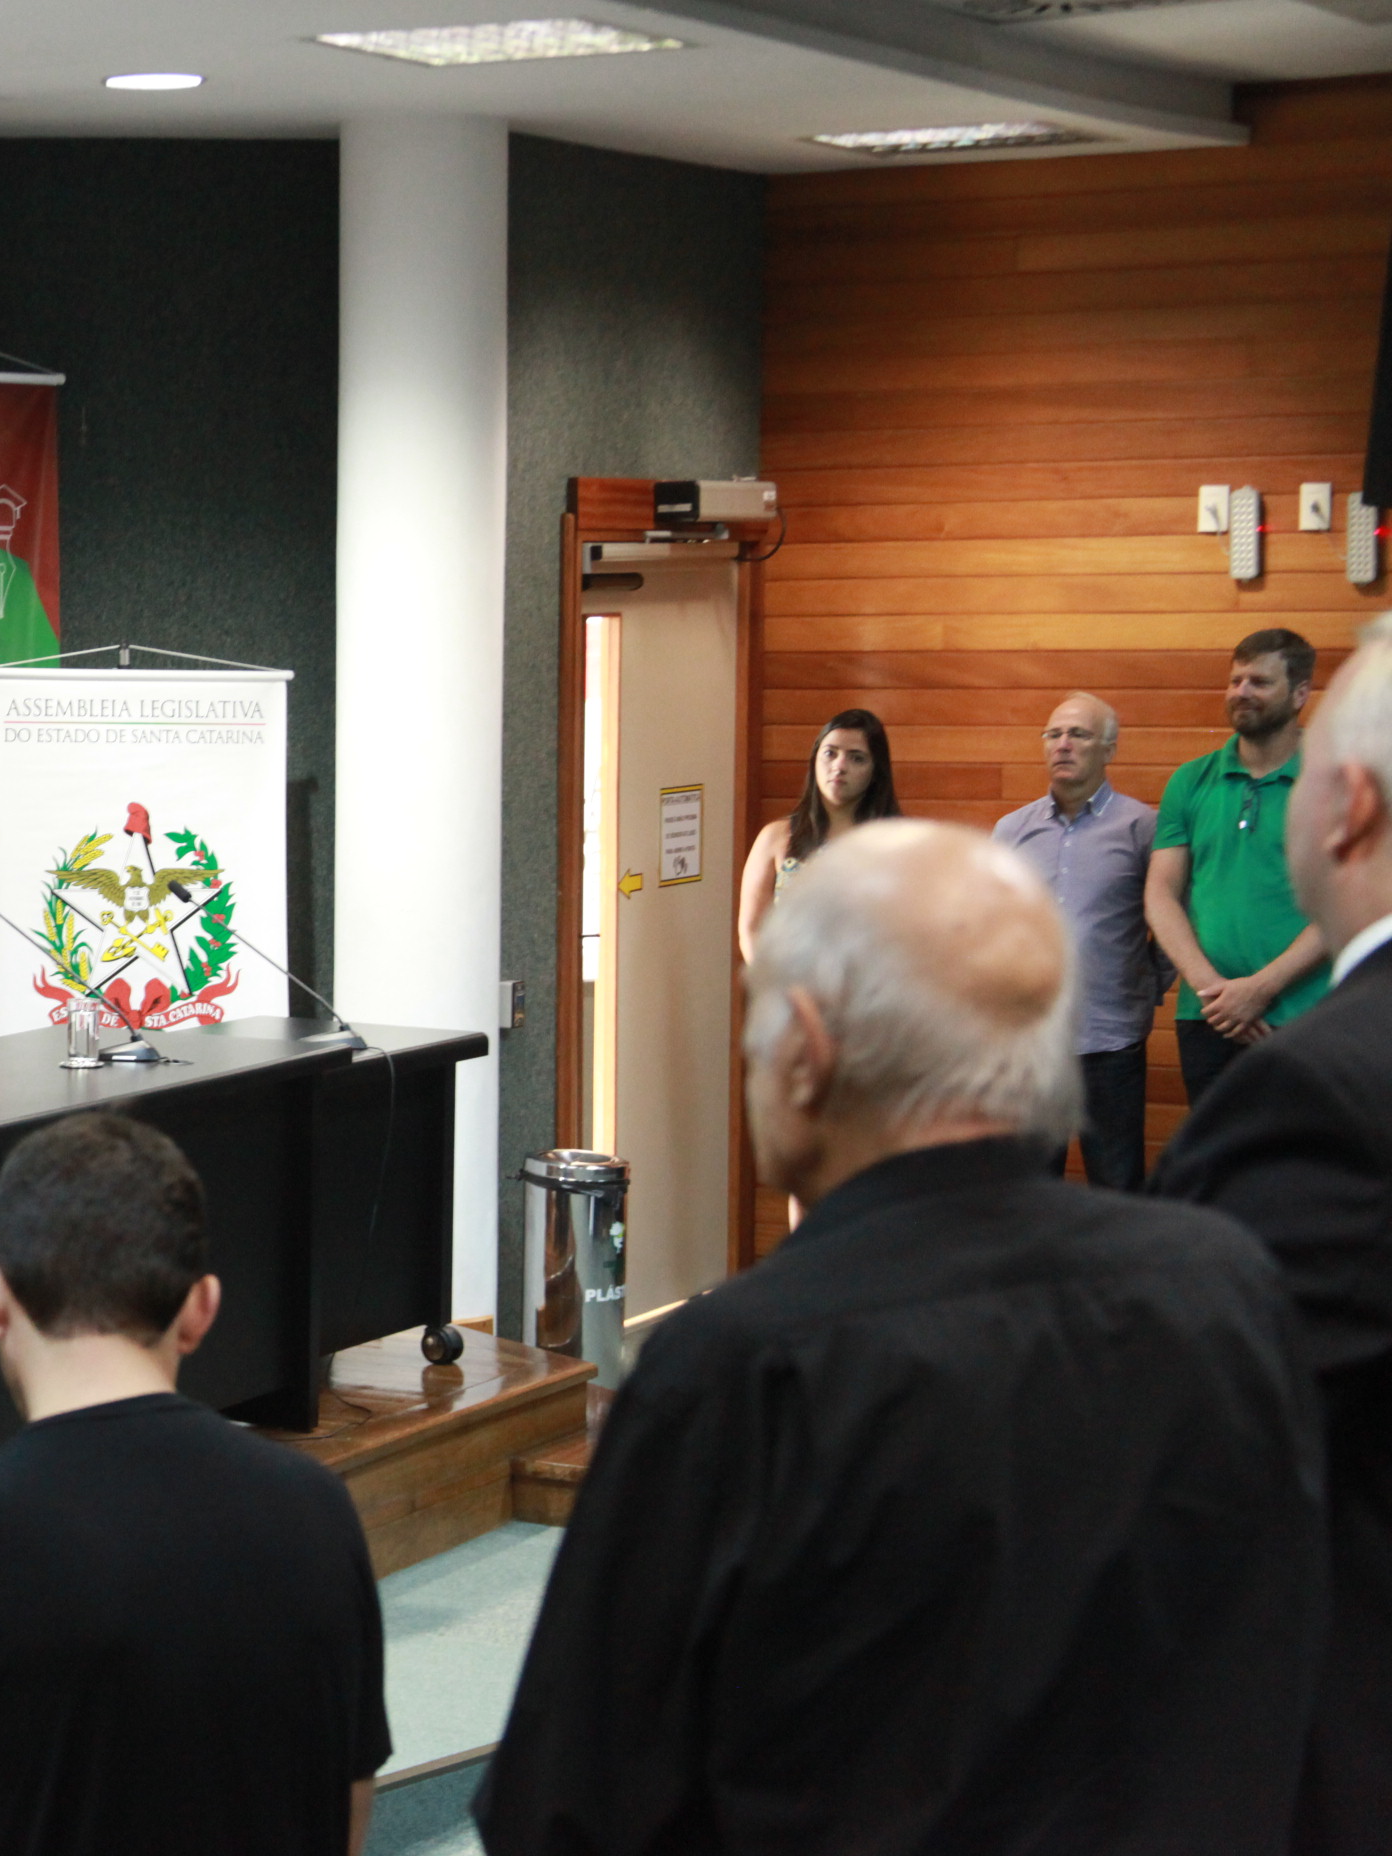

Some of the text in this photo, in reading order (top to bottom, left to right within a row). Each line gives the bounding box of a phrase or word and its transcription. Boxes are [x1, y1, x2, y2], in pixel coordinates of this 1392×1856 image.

[5, 698, 265, 719] ASSEMBLEIA LEGISLATIVA
[3, 727, 265, 745] DO ESTADO DE SANTA CATARINA
[585, 1284, 625, 1303] PLÁS
